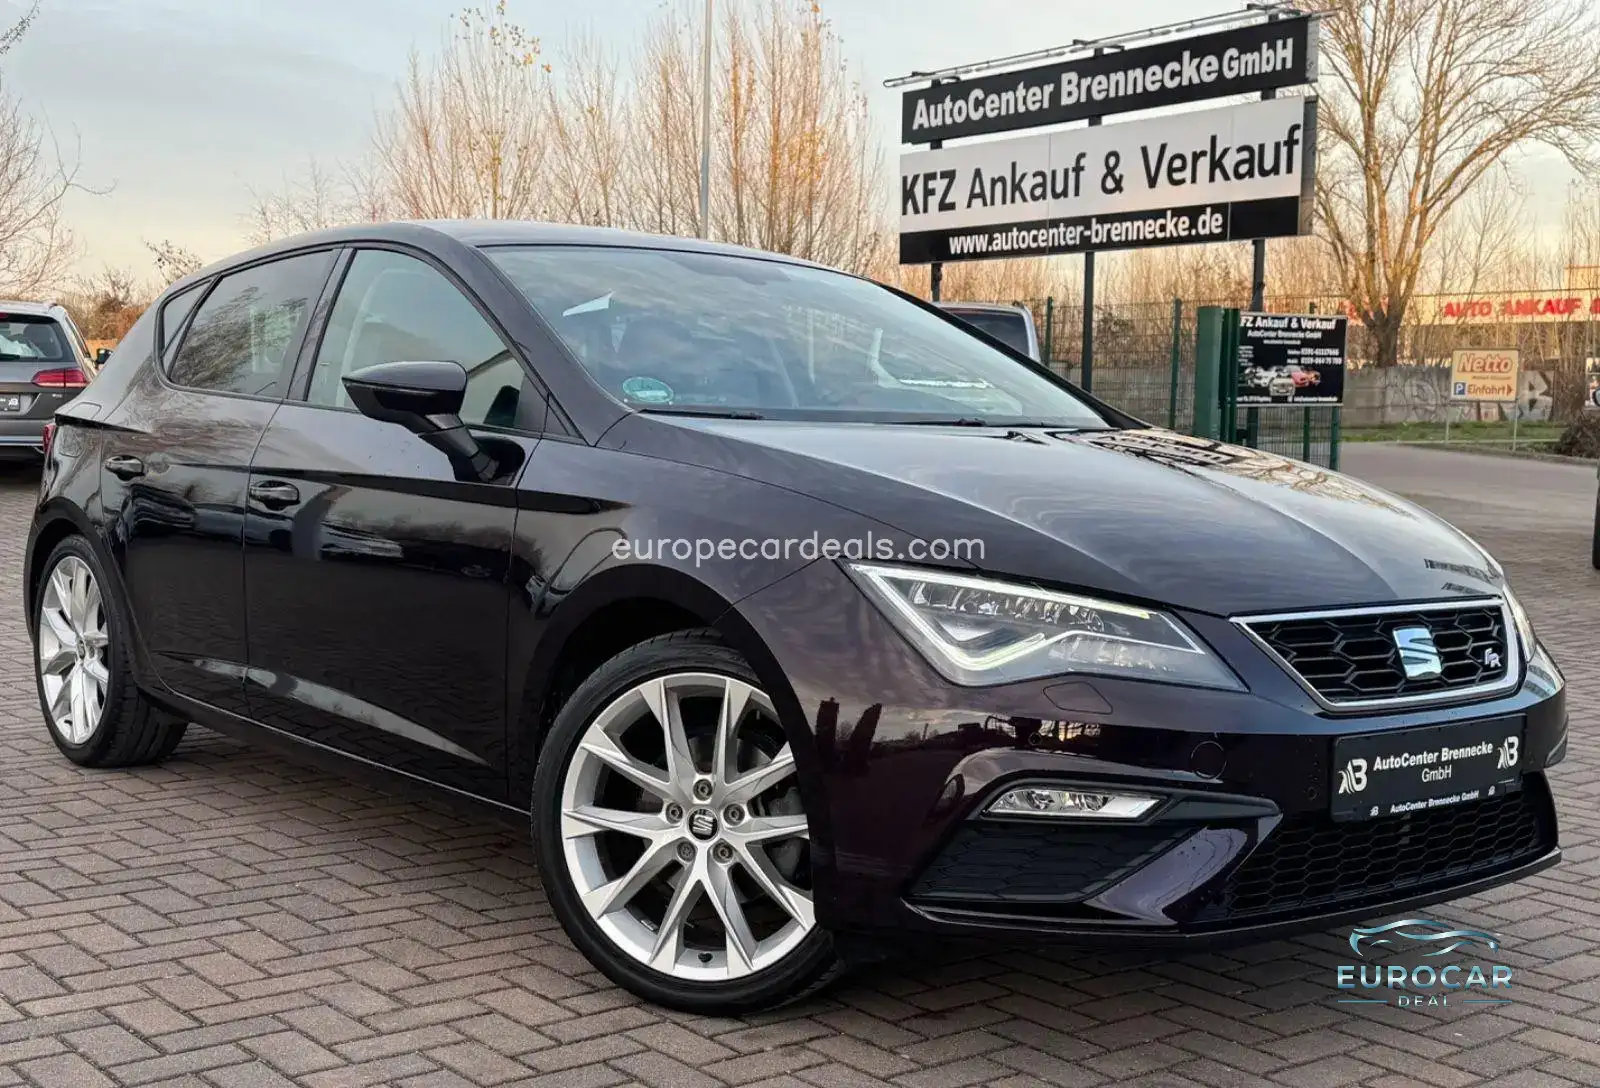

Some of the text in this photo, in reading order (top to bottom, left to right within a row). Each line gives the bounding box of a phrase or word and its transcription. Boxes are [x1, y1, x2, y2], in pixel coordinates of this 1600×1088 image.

[913, 38, 1294, 130] AutoCenter Brennecke GmbH
[901, 124, 1301, 216] KFZ Ankauf & Verkauf
[948, 206, 1223, 255] www.autocenter-brennecke.de
[1443, 300, 1492, 318] AUTO
[1503, 297, 1582, 316] ANKAUF
[1255, 317, 1288, 328] Ankauf
[1290, 317, 1298, 329] &
[1300, 318, 1337, 330] Verkauf
[1457, 352, 1513, 374] Netto
[1467, 383, 1506, 396] Einfahrt
[1373, 750, 1438, 771] AutoCenter
[1441, 742, 1493, 760] Brennecke
[1421, 765, 1452, 783] GmbH
[1390, 800, 1427, 814] AutoCenter
[1428, 795, 1460, 808] Brennecke
[1461, 789, 1480, 801] GmbH
